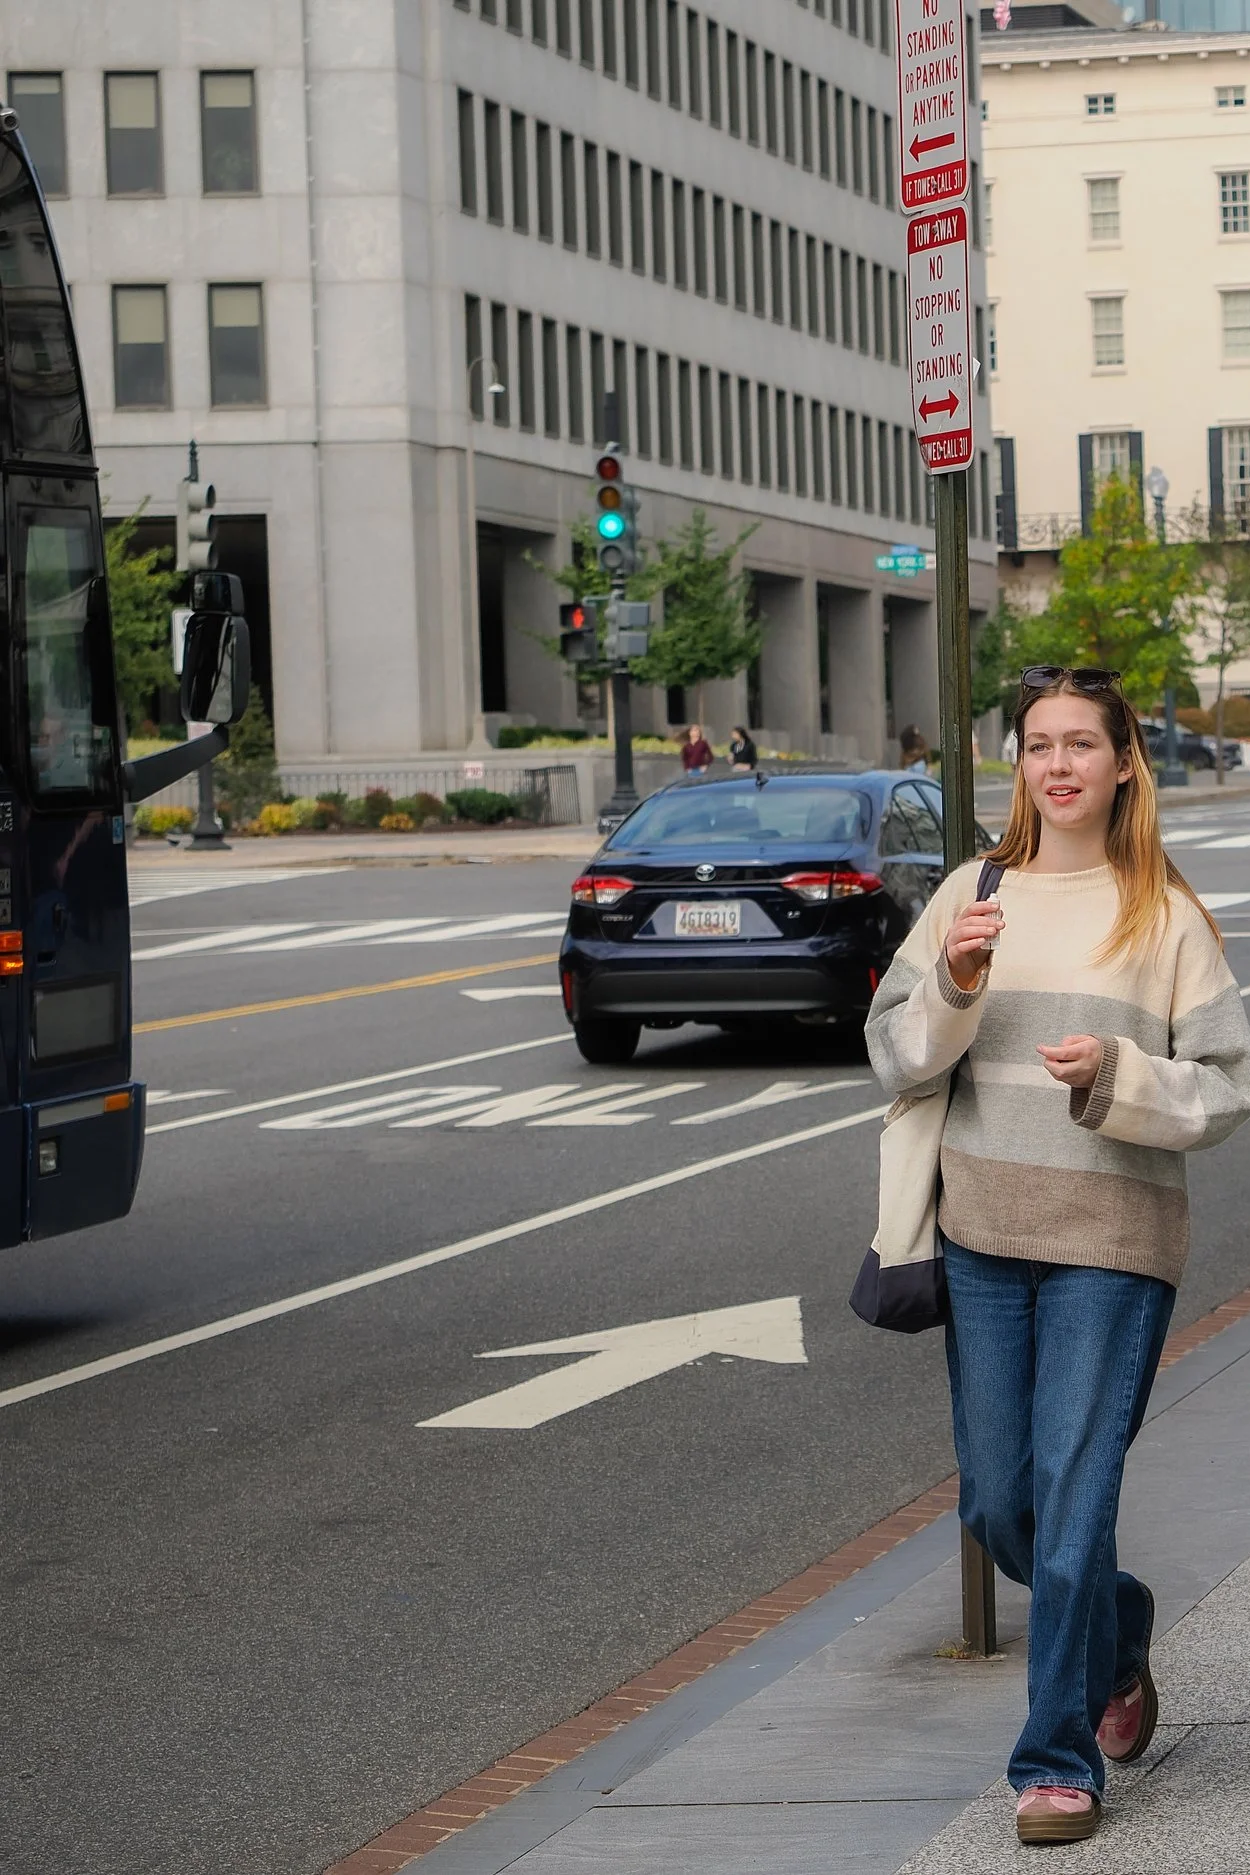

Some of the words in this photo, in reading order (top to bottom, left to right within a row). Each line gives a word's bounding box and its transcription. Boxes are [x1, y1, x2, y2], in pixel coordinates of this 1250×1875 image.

[922, 0, 938, 19] NO
[907, 20, 955, 58] STANDING
[905, 74, 915, 94] OR
[916, 55, 958, 90] PARKING
[913, 91, 955, 127] ANYTIME
[906, 180, 912, 201] IF
[914, 175, 937, 199] TOWED
[937, 171, 952, 193] CALL
[954, 168, 963, 189] 311
[914, 222, 930, 248] TOW
[934, 215, 958, 243] AWAY
[929, 255, 943, 281] NO
[915, 288, 961, 321] STOPPING
[931, 324, 944, 347] OR
[916, 352, 962, 384] STANDING
[943, 438, 958, 459] CALL
[959, 436, 968, 457] 311
[260, 1080, 872, 1128] ONLY
